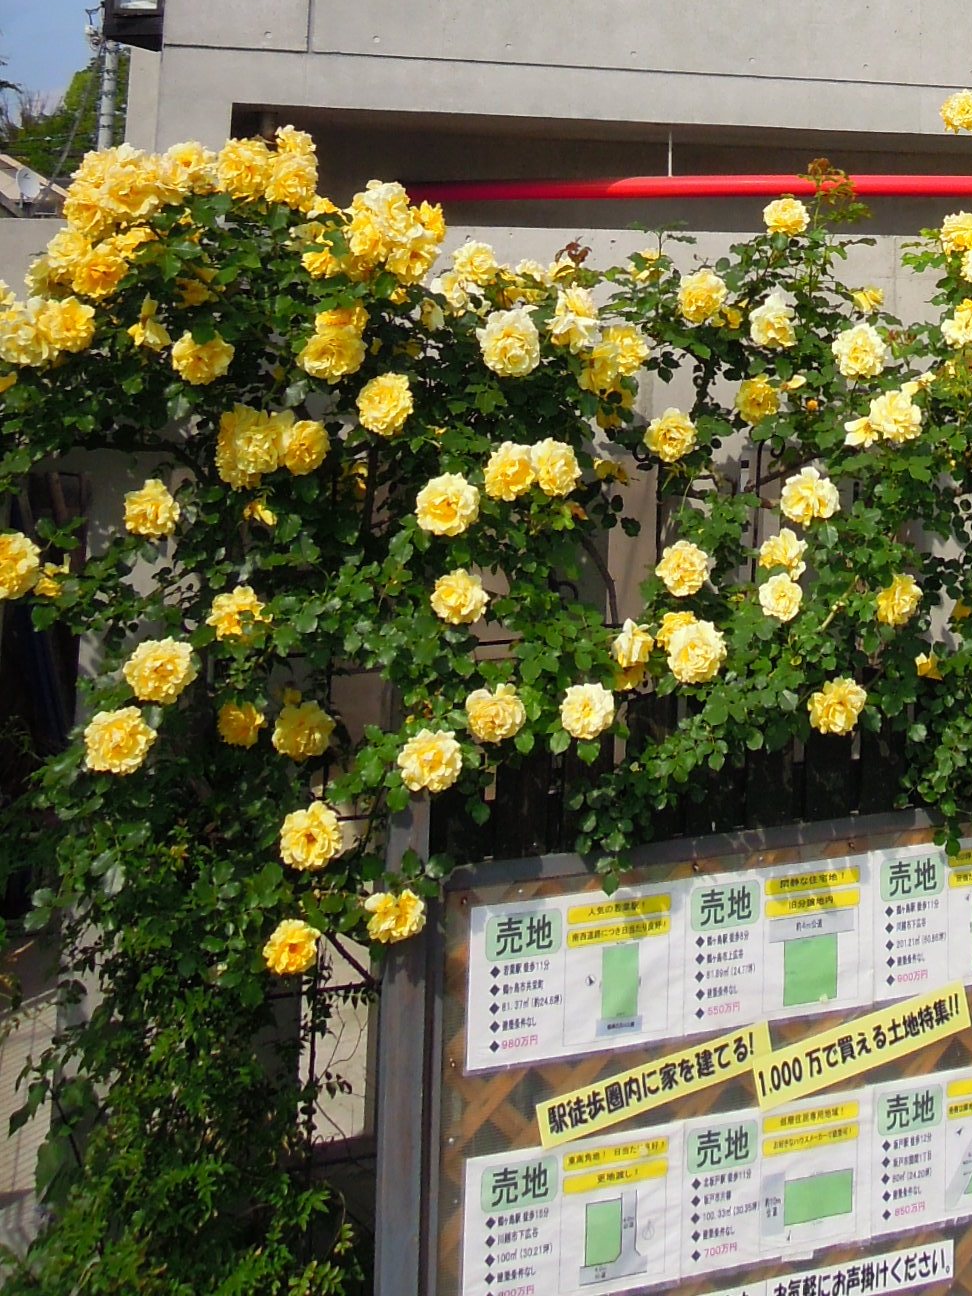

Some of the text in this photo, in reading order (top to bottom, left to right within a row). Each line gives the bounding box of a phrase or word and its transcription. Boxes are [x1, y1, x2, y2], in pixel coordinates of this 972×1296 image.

[889, 858, 937, 897] 売地
[700, 886, 752, 926] 売地
[496, 913, 553, 956] 売地
[886, 1090, 935, 1130] 売地
[696, 1125, 750, 1169] 売地
[491, 1161, 549, 1207] 売地
